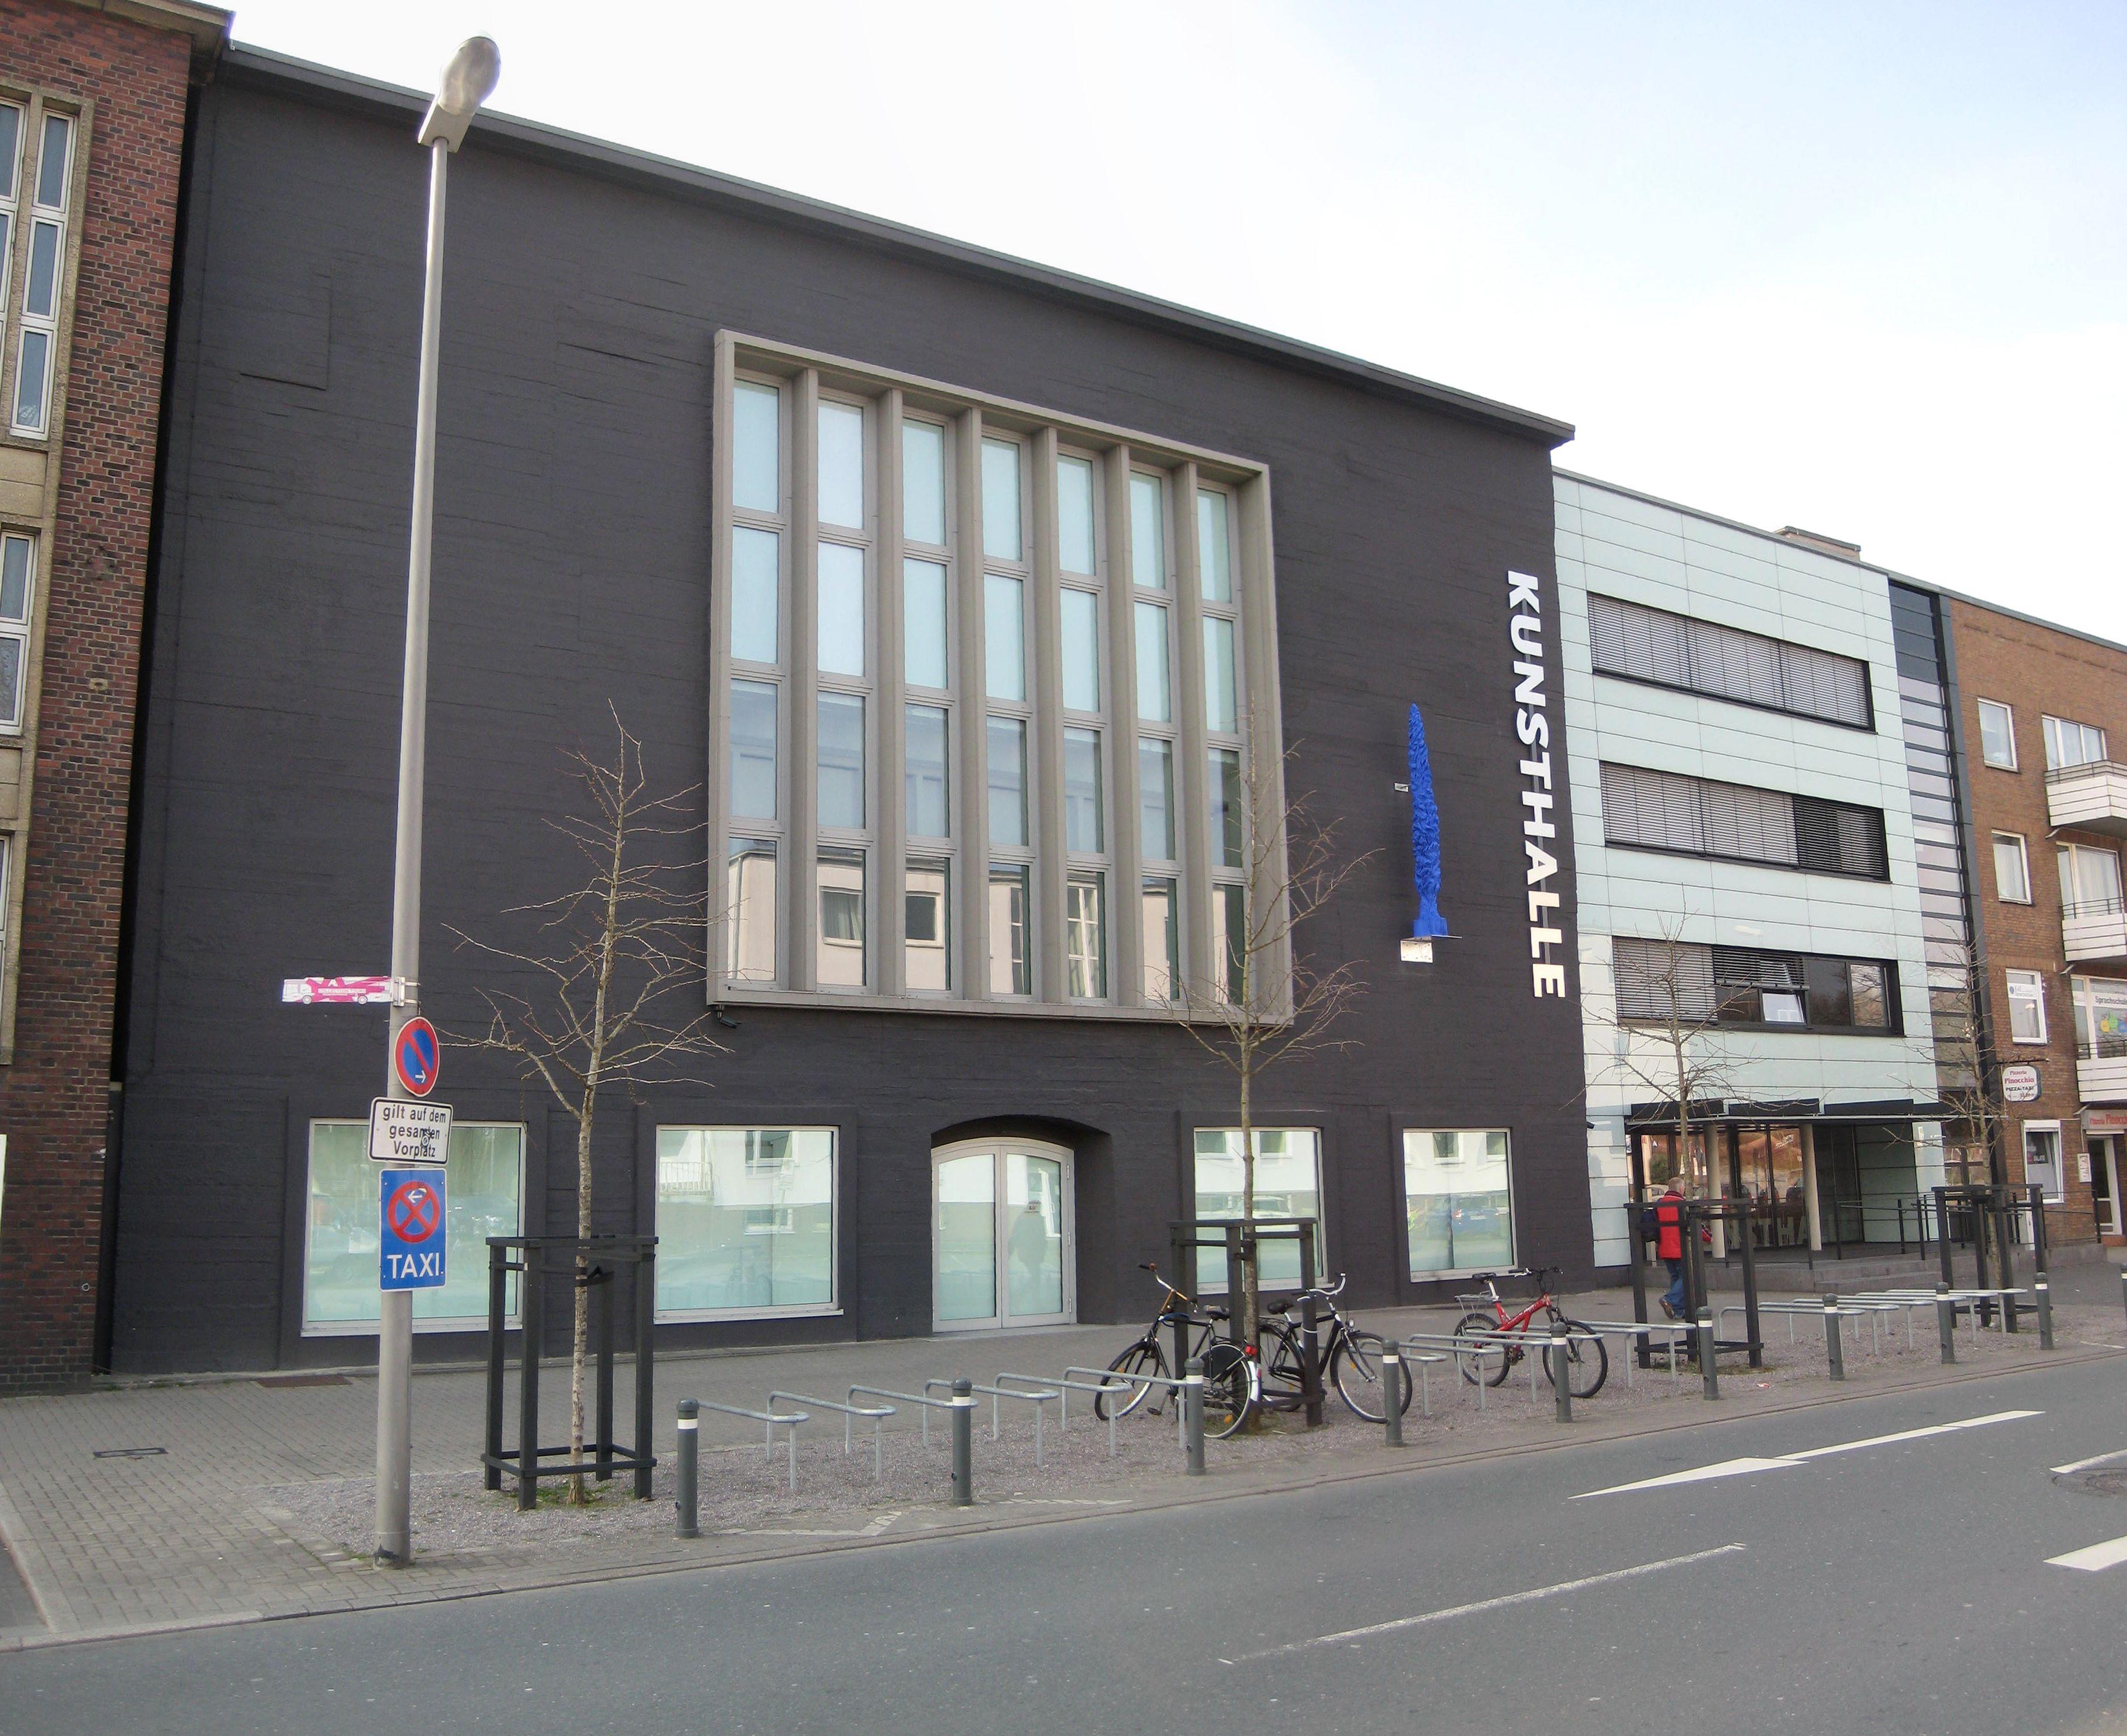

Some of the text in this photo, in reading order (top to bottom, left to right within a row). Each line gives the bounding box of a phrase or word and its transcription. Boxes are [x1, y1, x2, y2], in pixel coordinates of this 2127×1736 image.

[1507, 570, 1566, 998] KUNSTHALLE
[383, 1105, 446, 1123] gilt auf dem
[394, 1141, 436, 1159] Vorplatz
[387, 1252, 439, 1279] TAXI
